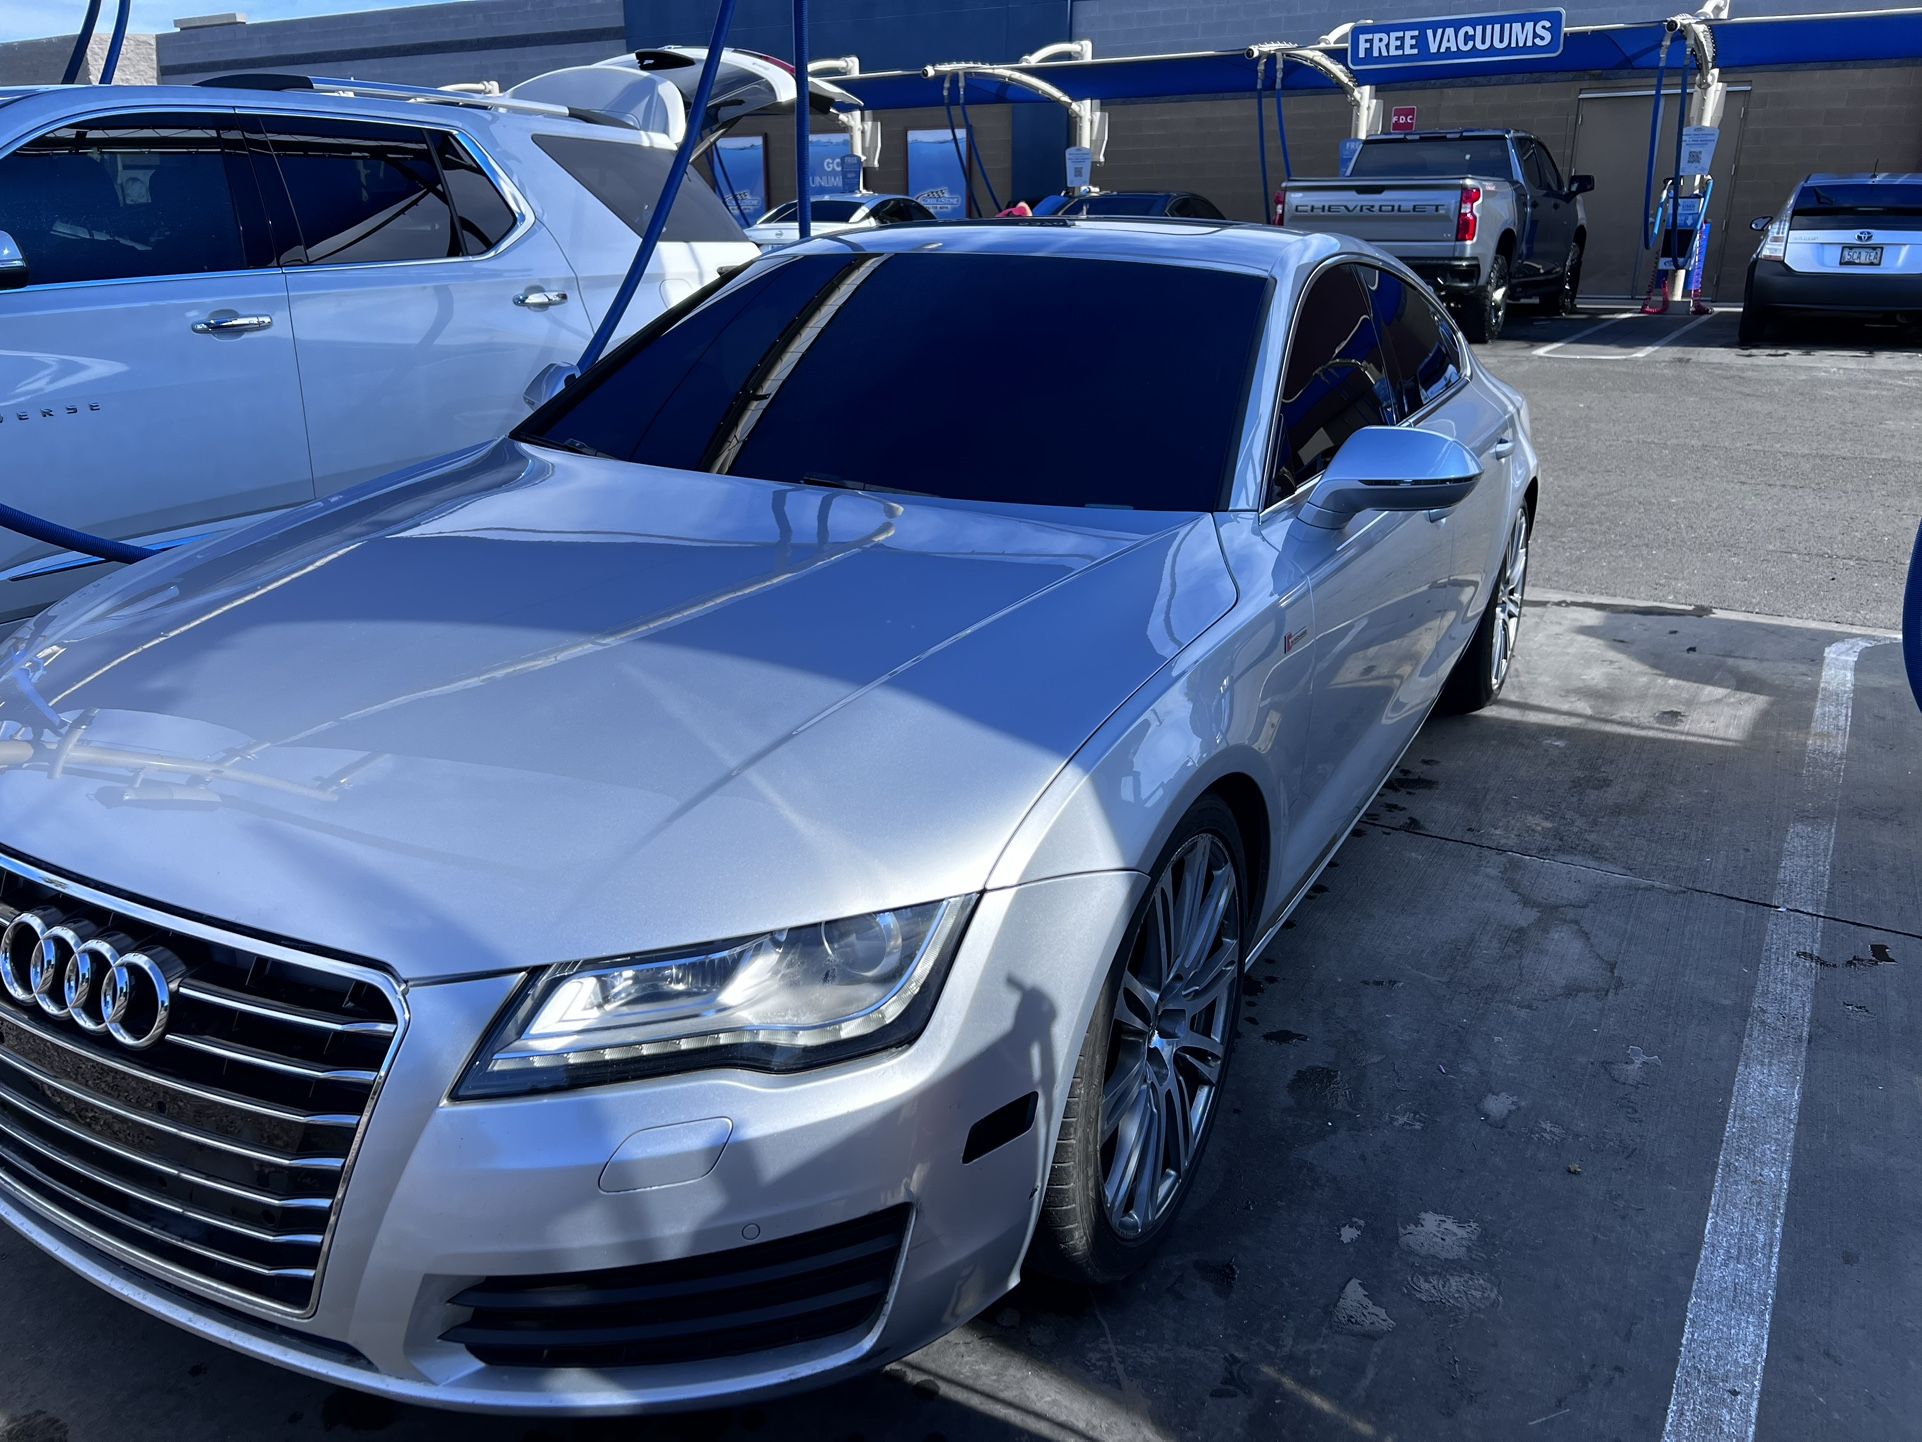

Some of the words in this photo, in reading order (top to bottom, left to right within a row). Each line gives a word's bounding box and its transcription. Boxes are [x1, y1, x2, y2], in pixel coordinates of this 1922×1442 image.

[1358, 30, 1418, 58] FREE
[1426, 20, 1551, 53] VACUUMS
[809, 175, 843, 187] UNLIMI
[1294, 204, 1446, 214] CHEVROLET
[0, 402, 101, 424] ERSE
